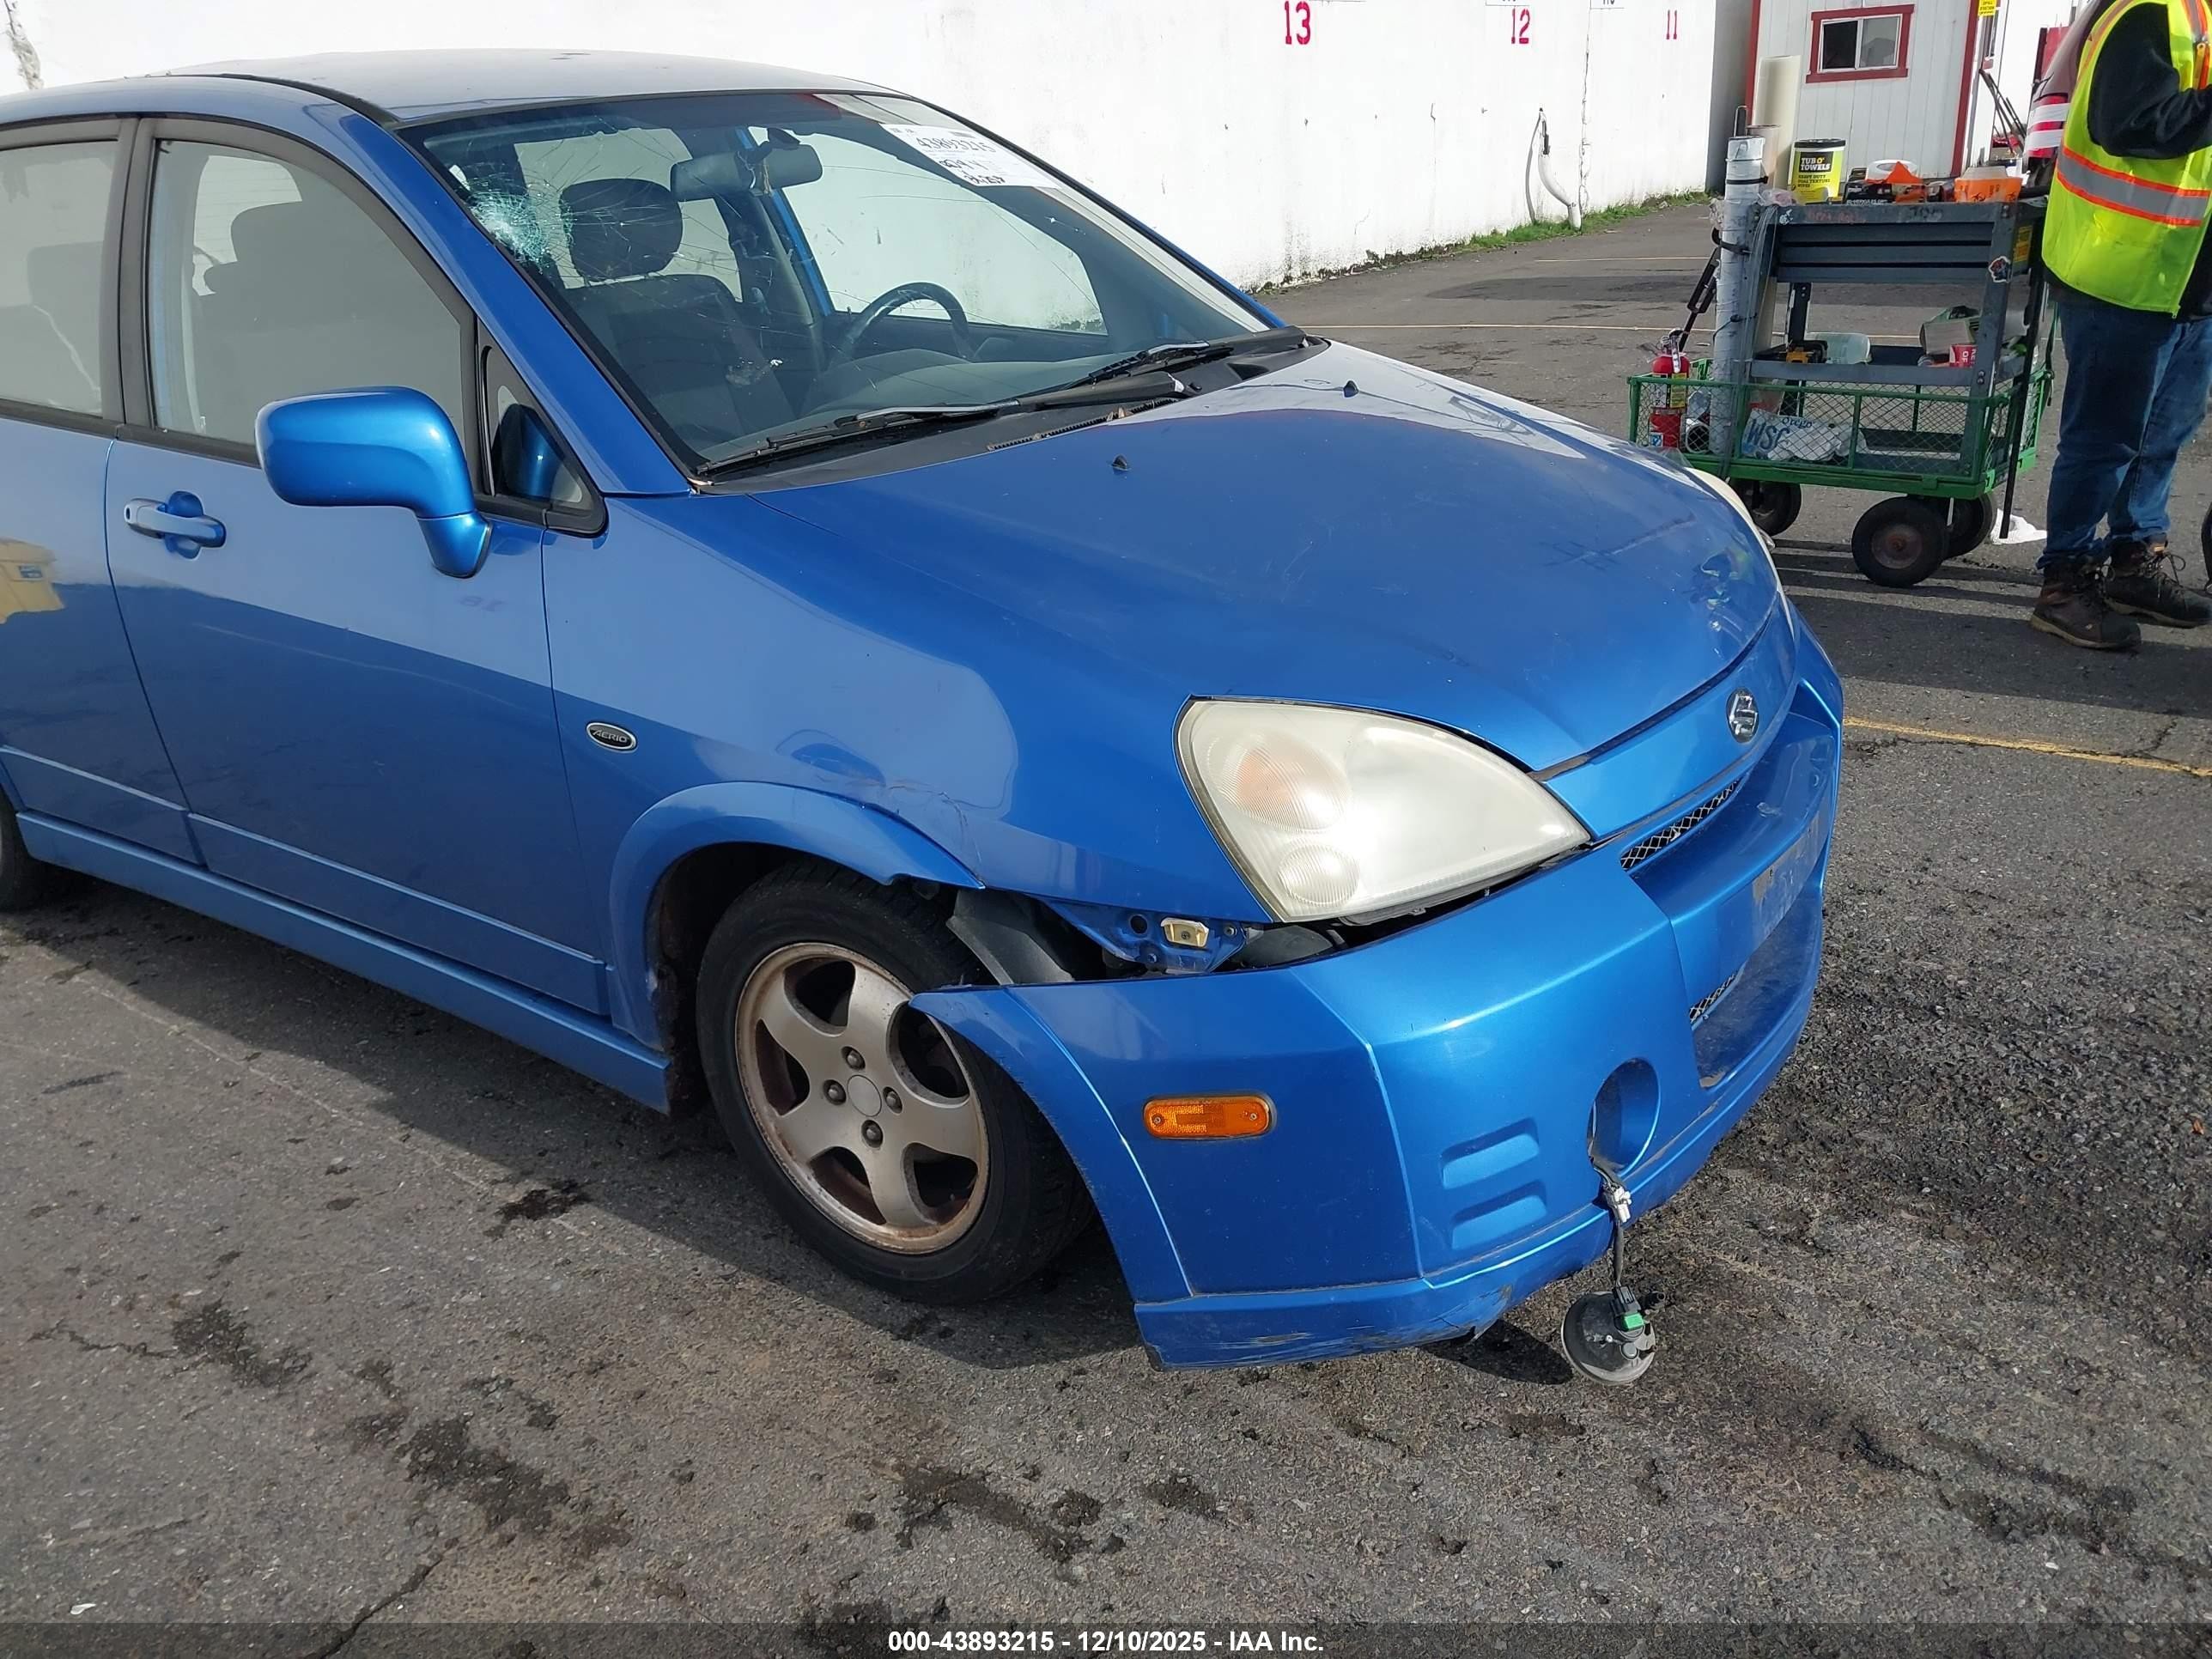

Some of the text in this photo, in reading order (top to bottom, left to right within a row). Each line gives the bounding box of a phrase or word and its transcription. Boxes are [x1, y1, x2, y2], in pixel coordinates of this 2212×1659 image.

[1284, 1, 1311, 45] 13
[1510, 8, 1531, 44] 12
[1666, 9, 1678, 40] 11
[1782, 417, 1813, 429] Orego
[592, 729, 628, 743] AERIO
